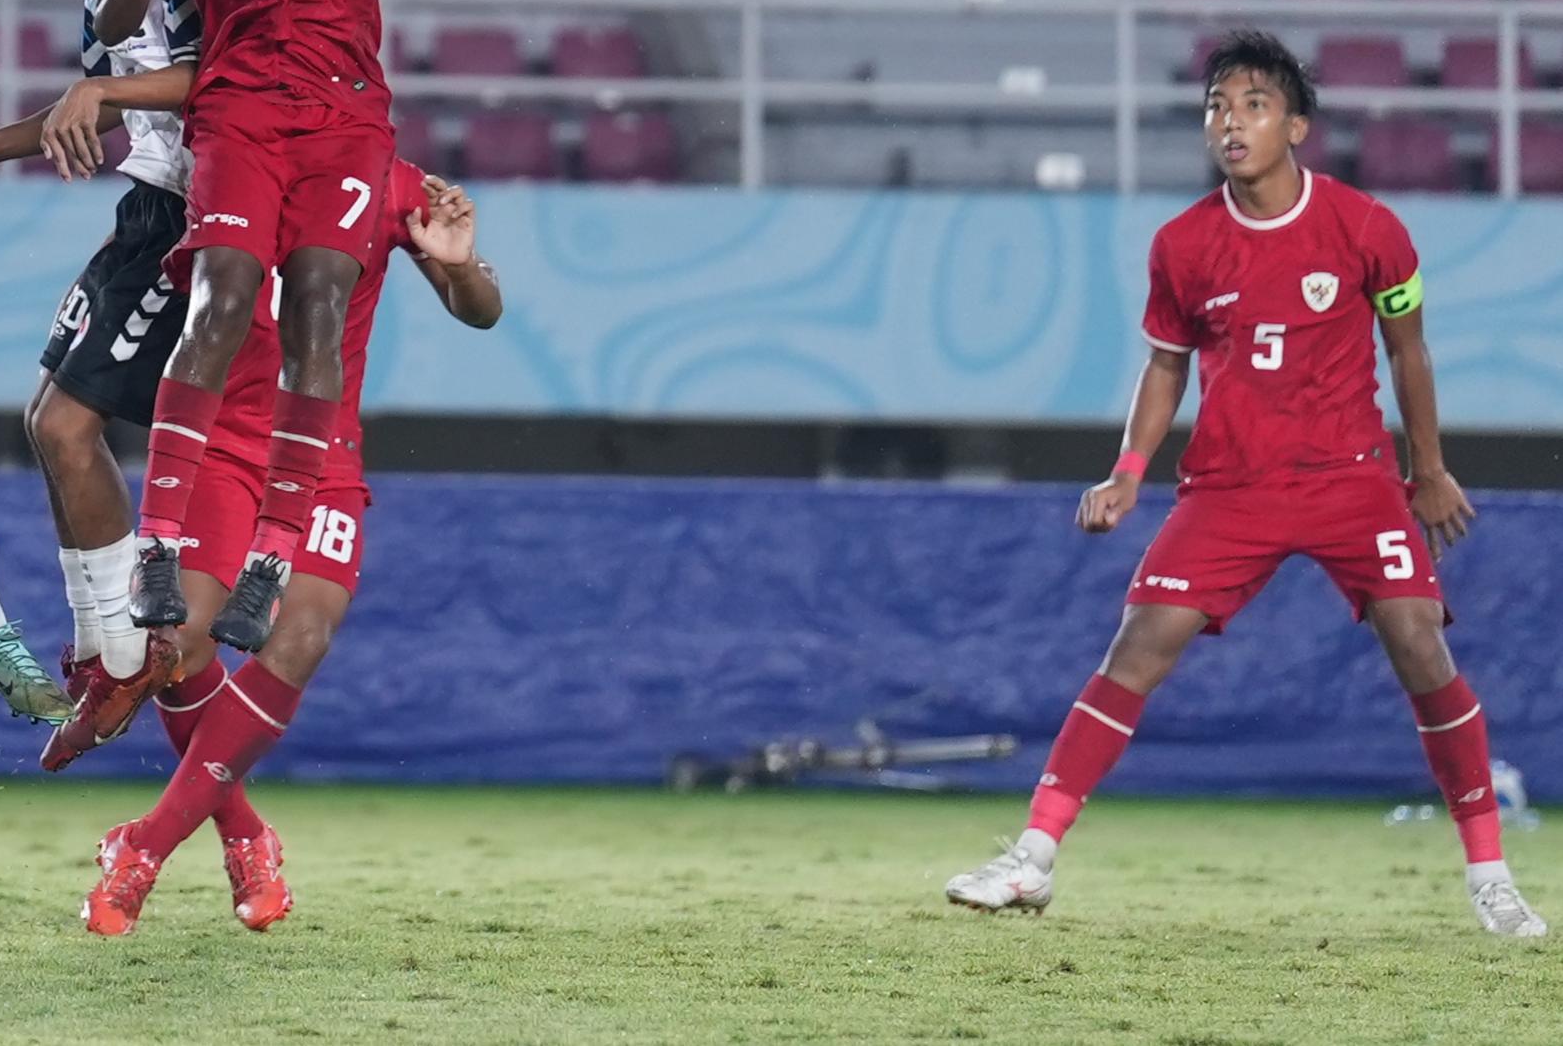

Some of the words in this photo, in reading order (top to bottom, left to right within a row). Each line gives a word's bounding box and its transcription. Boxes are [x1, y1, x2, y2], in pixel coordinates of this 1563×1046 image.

[202, 213, 248, 228] erspo
[340, 176, 372, 230] 7
[1382, 288, 1410, 315] C
[1250, 322, 1286, 371] 5
[305, 505, 357, 564] 18
[1375, 530, 1414, 581] 5
